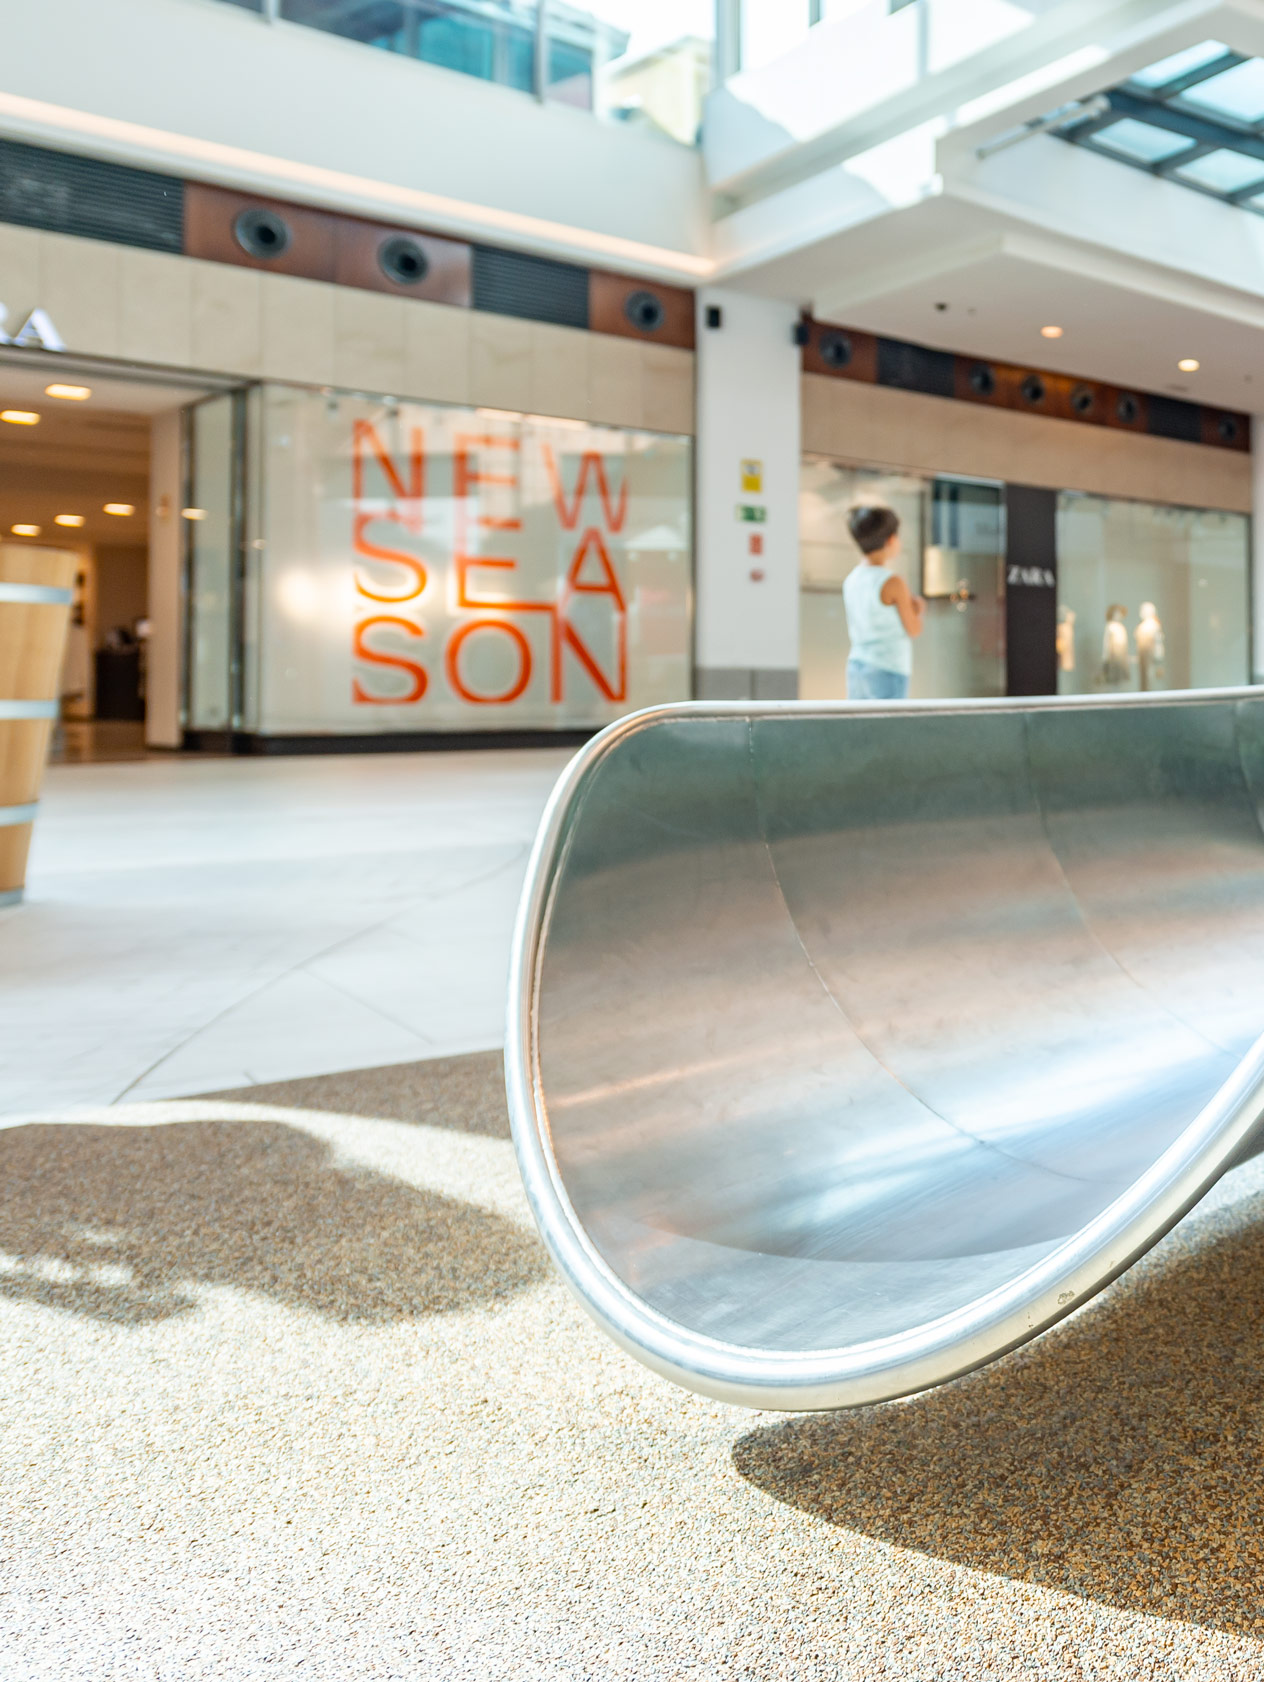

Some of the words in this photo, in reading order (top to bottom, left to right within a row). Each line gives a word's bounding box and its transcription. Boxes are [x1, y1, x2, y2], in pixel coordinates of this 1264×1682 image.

[0, 302, 67, 352] A
[352, 418, 630, 535] NEW
[352, 614, 629, 706] SON
